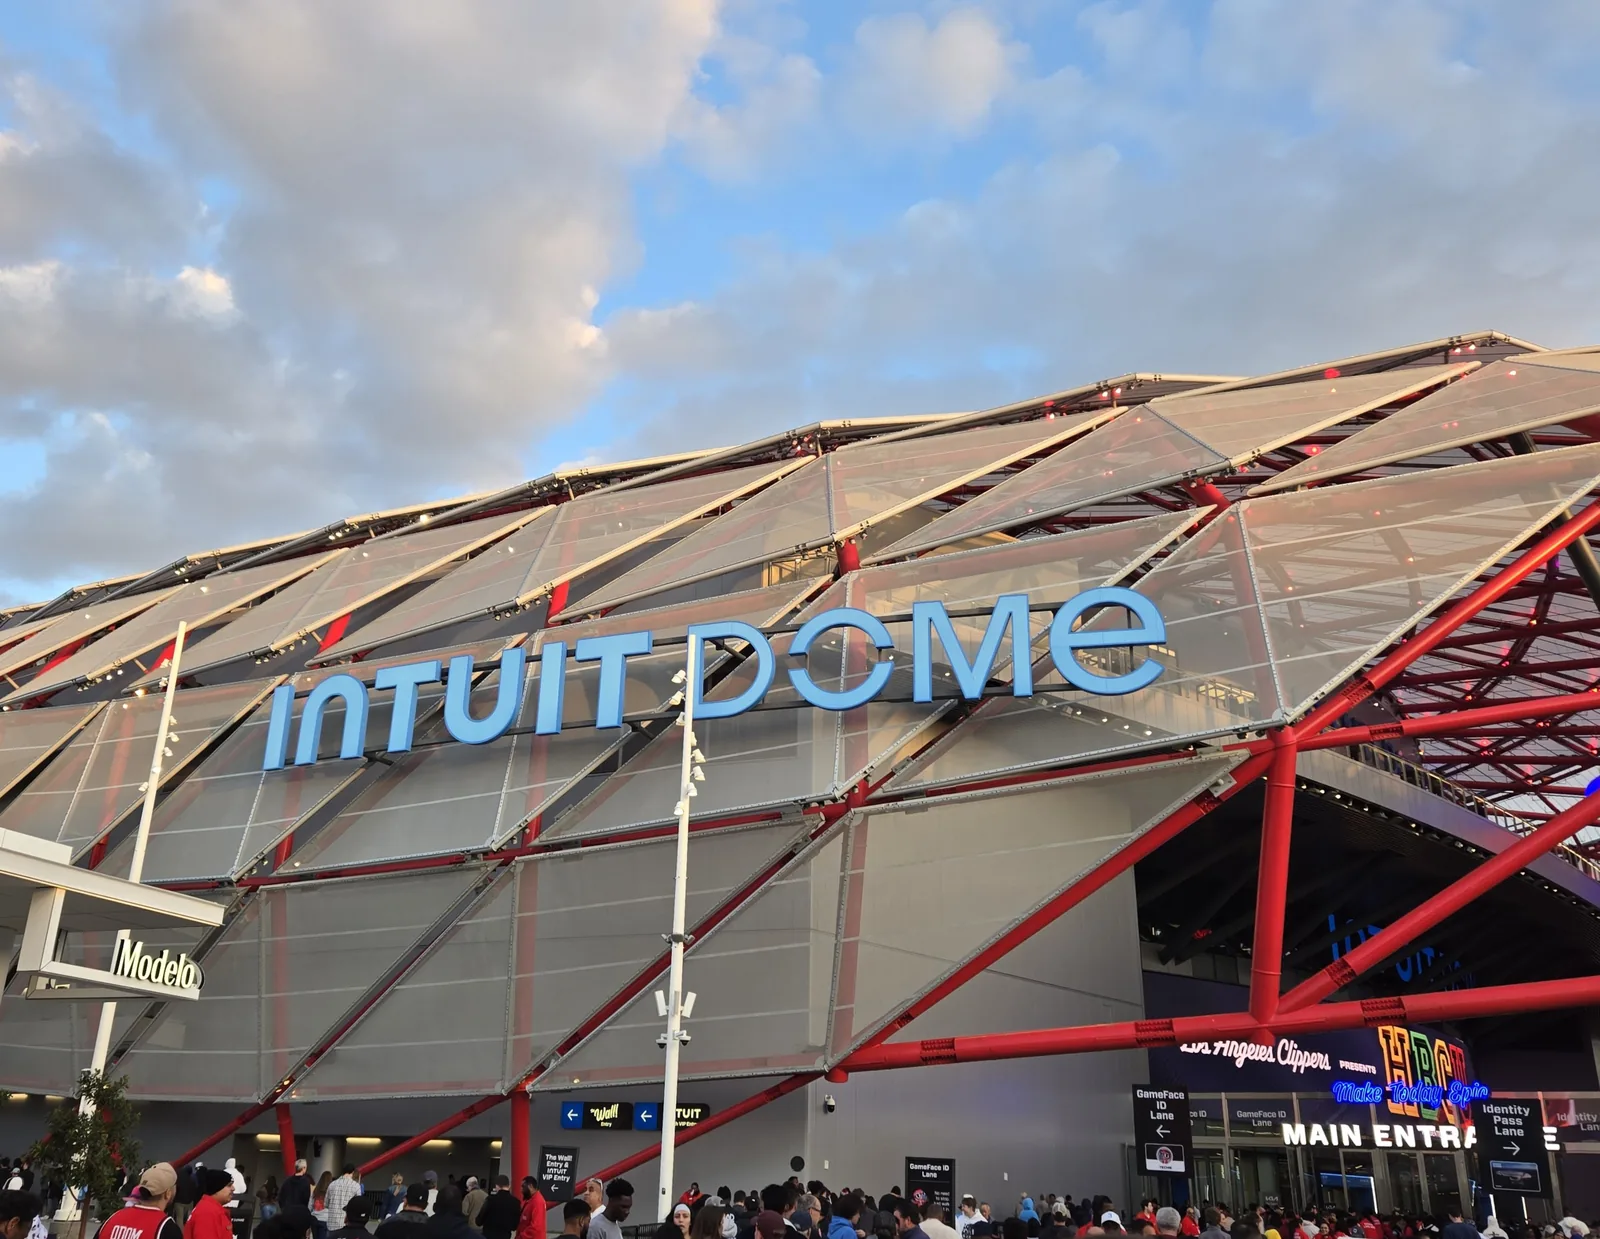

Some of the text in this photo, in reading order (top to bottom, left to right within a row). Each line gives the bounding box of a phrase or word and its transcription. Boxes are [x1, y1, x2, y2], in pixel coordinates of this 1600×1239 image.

[263, 630, 653, 770] INTUIT
[116, 938, 195, 989] Modelo
[1213, 1040, 1276, 1068] Angeles
[1276, 1038, 1331, 1073] Clippers
[1339, 1060, 1377, 1074] PRESENTS
[1136, 1089, 1184, 1100] GameFace
[1332, 1080, 1489, 1109] Make Today Epic
[1156, 1101, 1167, 1110] ID
[1483, 1104, 1530, 1117] Identity
[675, 1108, 702, 1119] TUIT
[1150, 1110, 1174, 1121] Lane
[1199, 1110, 1207, 1118] ID
[1236, 1110, 1276, 1118] GameFace
[1556, 1112, 1598, 1123] Idntity
[1252, 1118, 1272, 1127] Lane
[1493, 1115, 1523, 1126] Pass
[1494, 1126, 1524, 1137] Lane
[1580, 1122, 1600, 1131] Lan
[1282, 1123, 1560, 1150] MAIN ENTRAE
[909, 1163, 941, 1171] GameFace
[109, 1224, 144, 1239] ODOM
